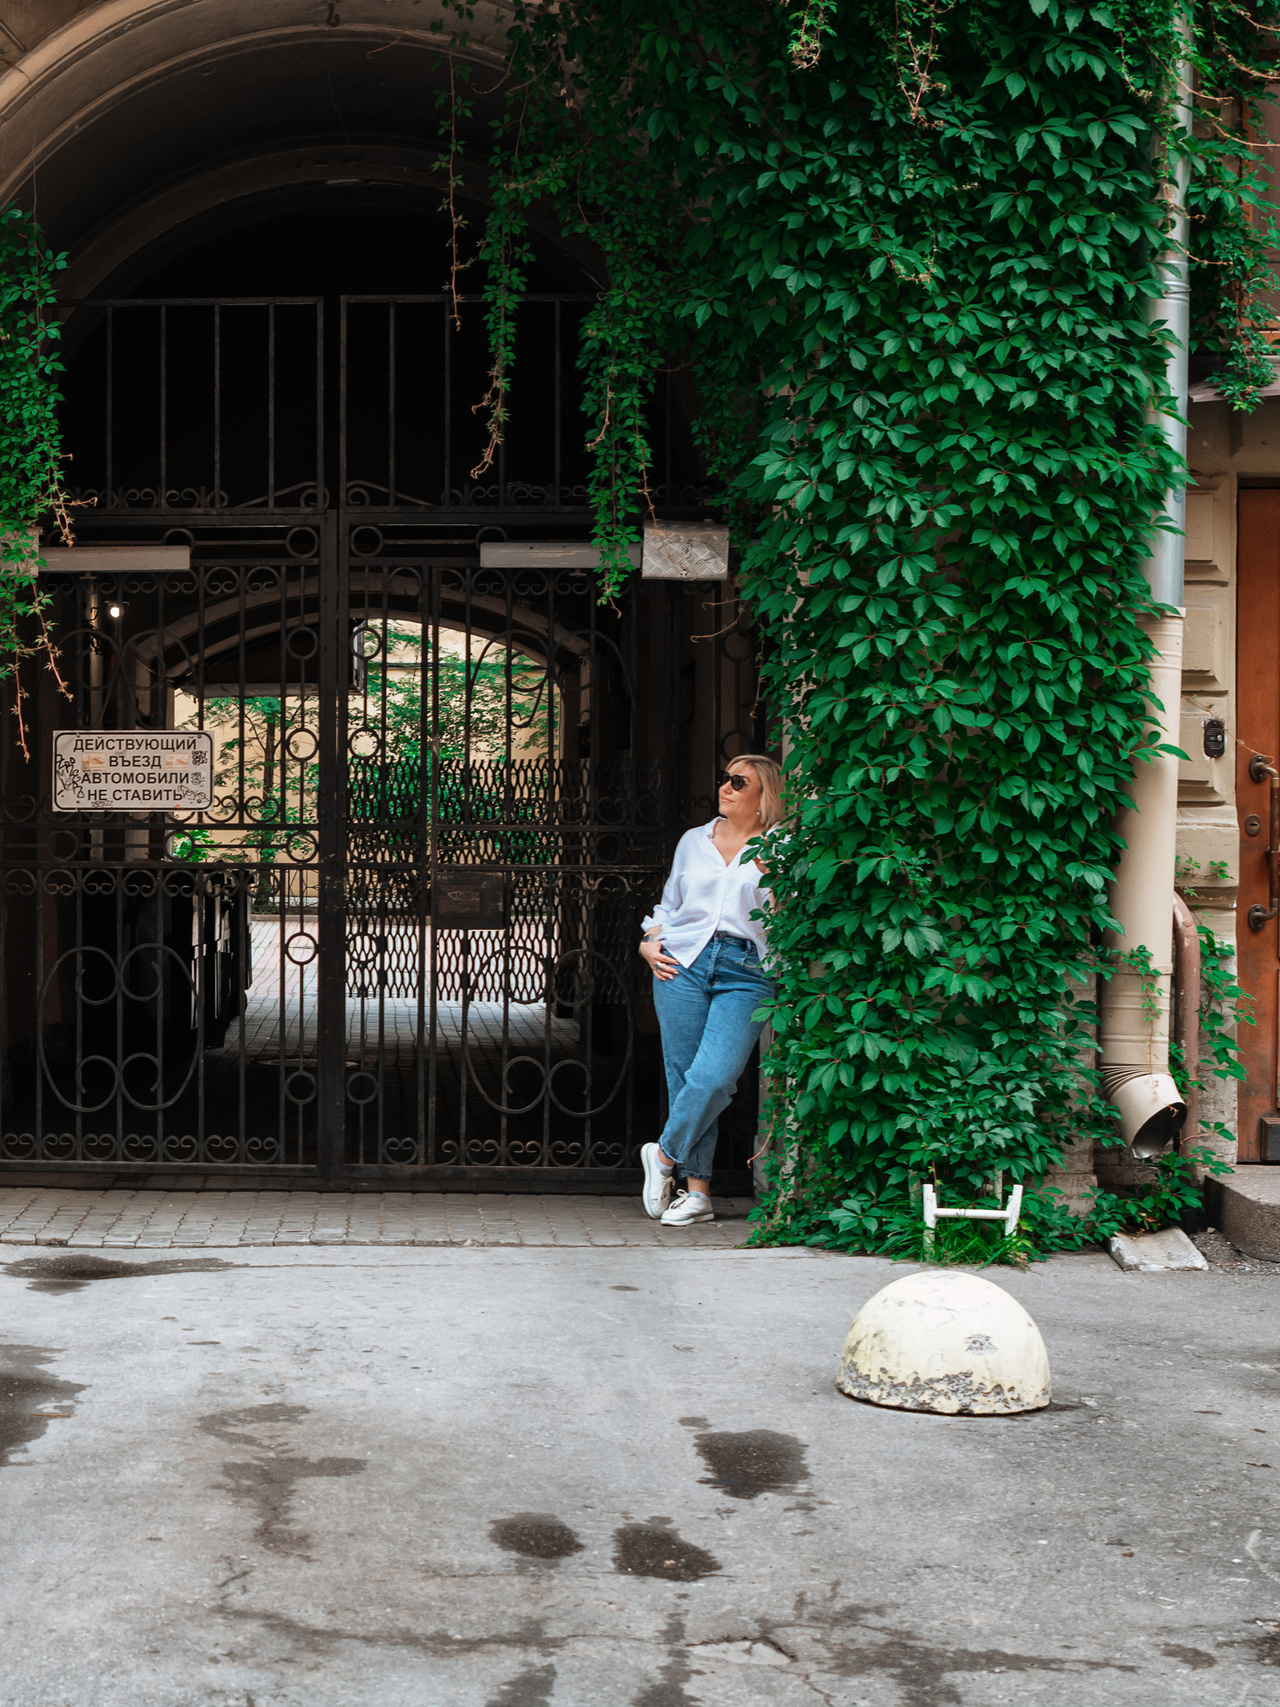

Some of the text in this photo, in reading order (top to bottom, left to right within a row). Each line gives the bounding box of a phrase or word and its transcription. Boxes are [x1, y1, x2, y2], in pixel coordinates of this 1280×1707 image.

[73, 736, 197, 752] ДЕЙСТВУЮЩИЙ
[109, 755, 162, 769] ВЪЕЗД
[81, 772, 189, 784] АВТОМОБИЛИ
[87, 789, 107, 801] НЕ
[112, 789, 183, 801] СТАВИТЬ
